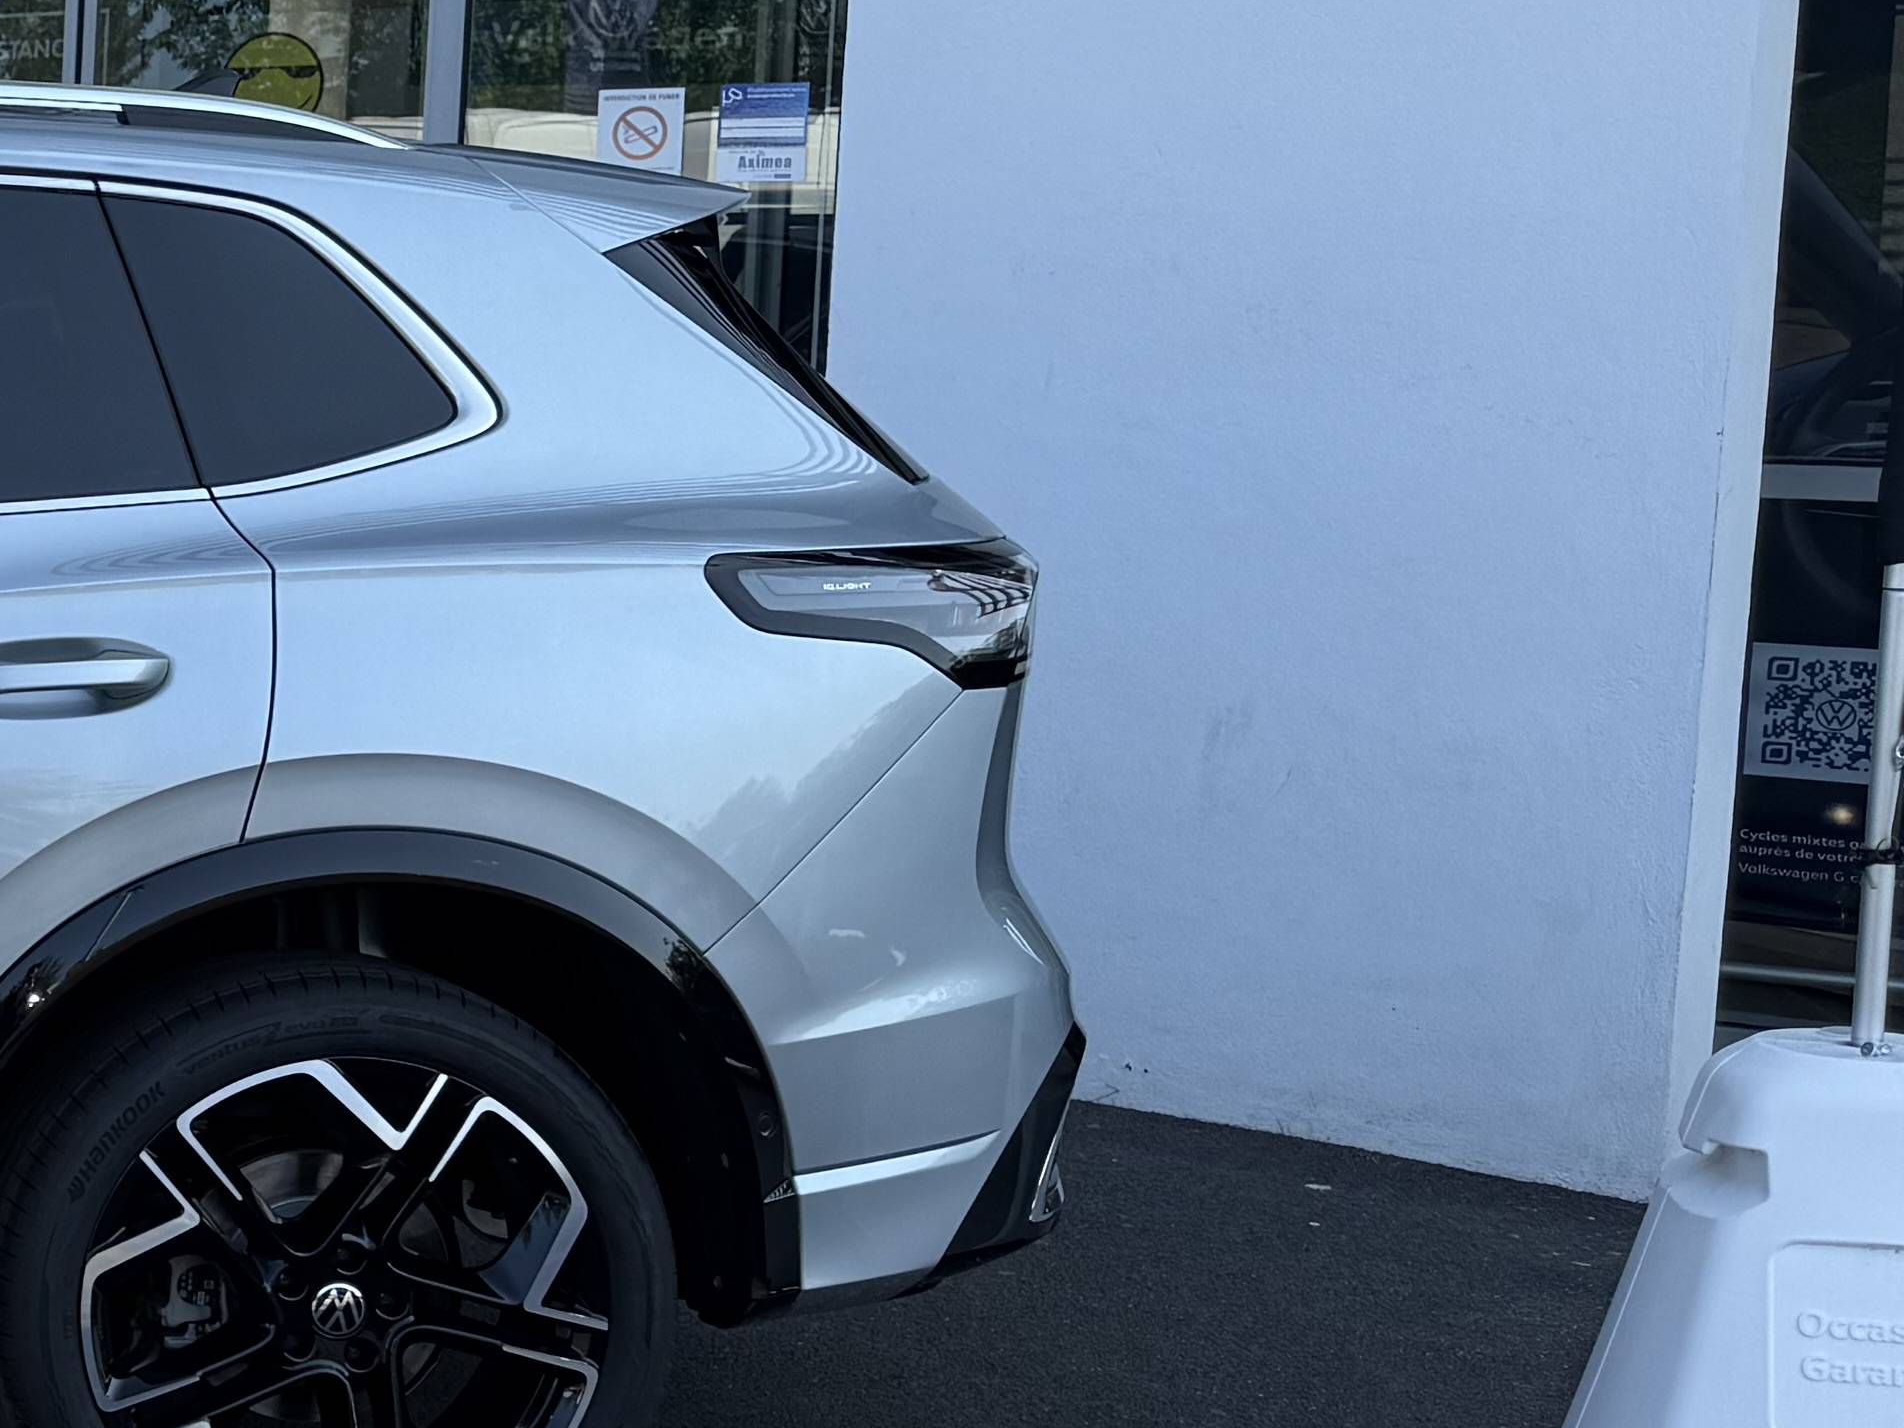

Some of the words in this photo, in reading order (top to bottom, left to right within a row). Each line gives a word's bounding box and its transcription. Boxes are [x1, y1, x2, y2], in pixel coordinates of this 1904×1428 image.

[1739, 828, 1789, 843] Cycles
[1792, 834, 1846, 849] mixtes
[1738, 861, 1829, 883] Volkswagen
